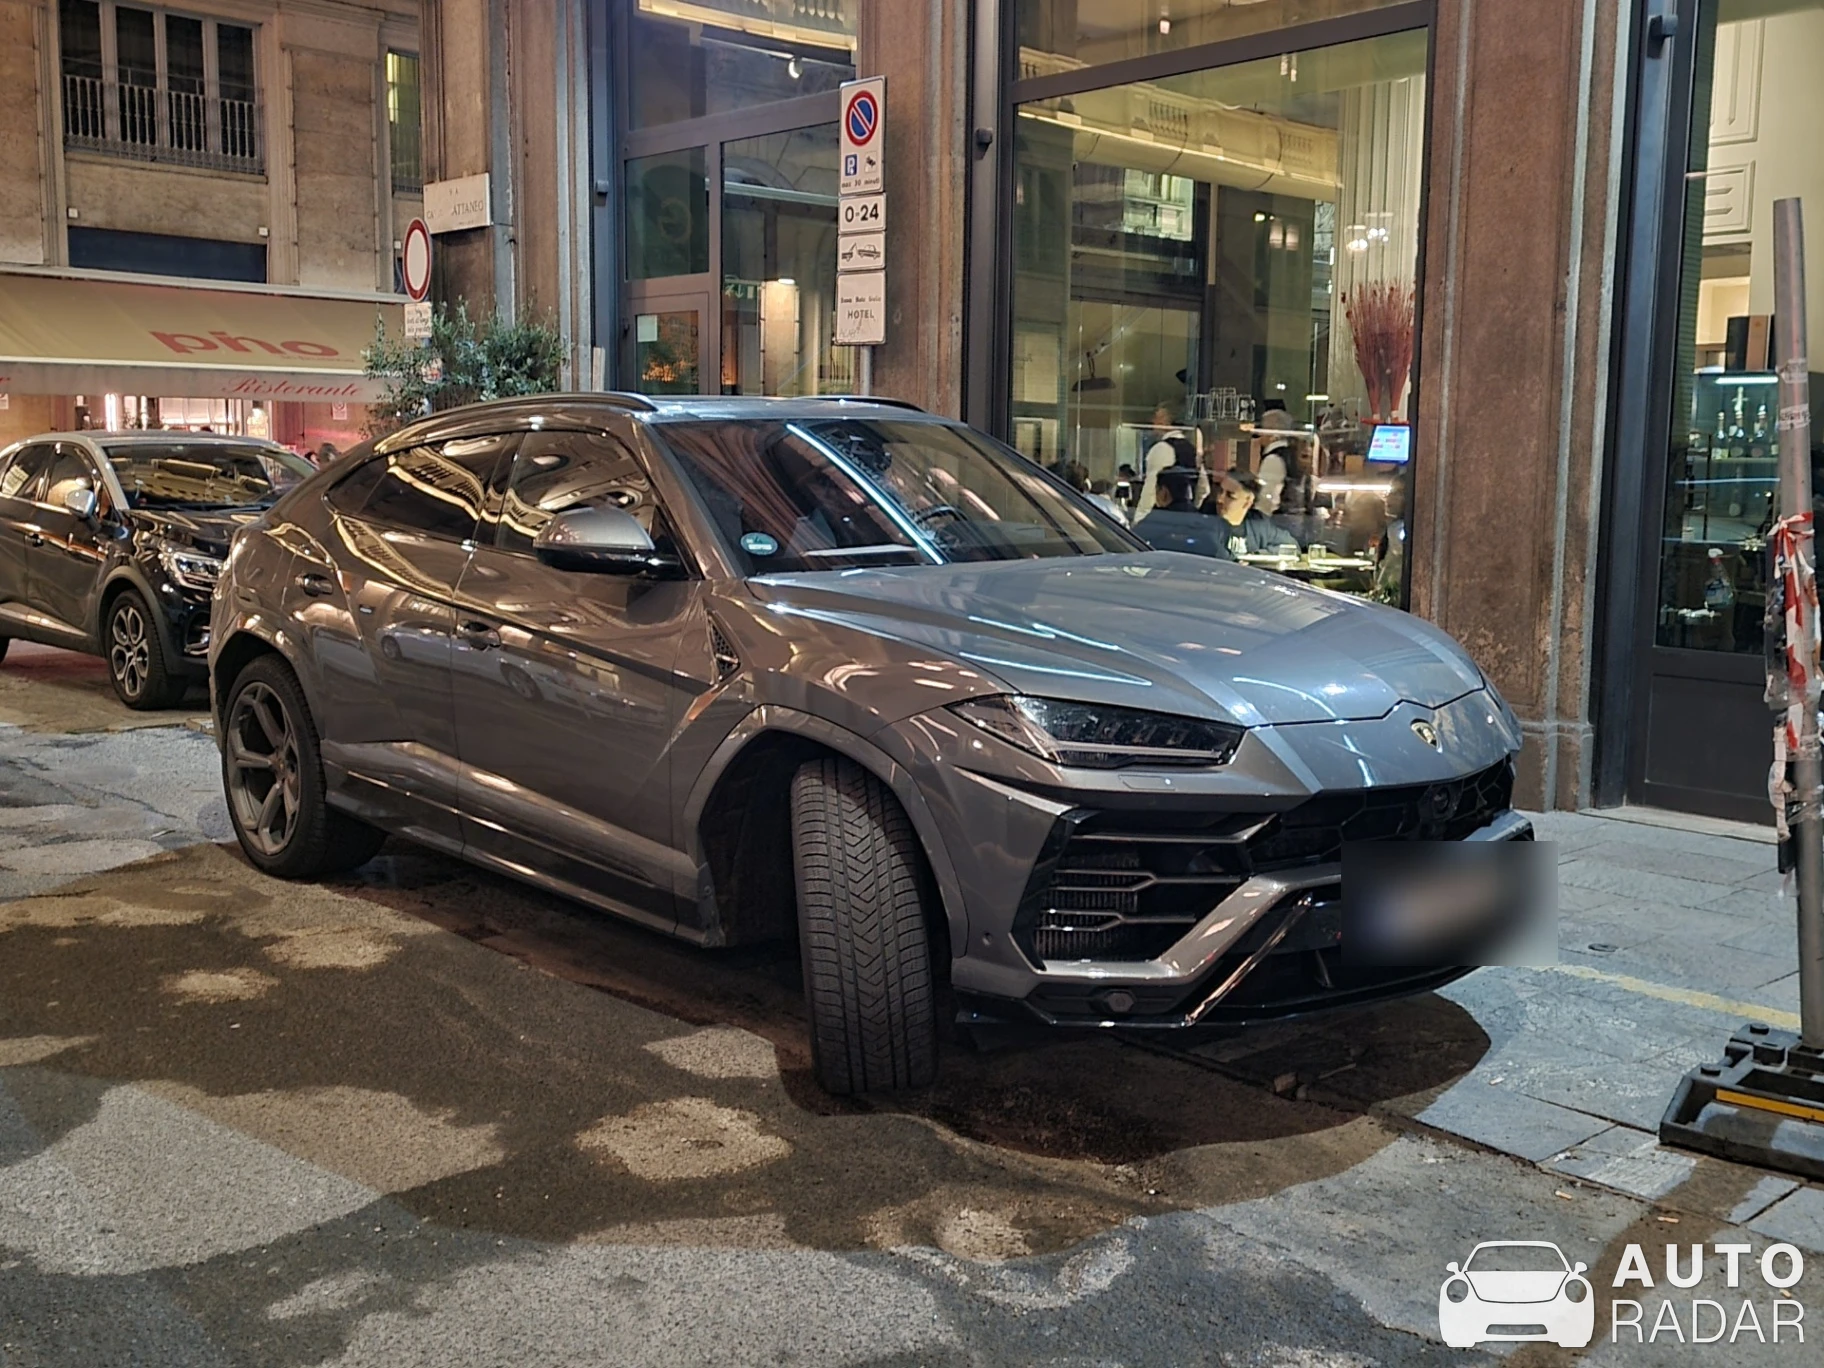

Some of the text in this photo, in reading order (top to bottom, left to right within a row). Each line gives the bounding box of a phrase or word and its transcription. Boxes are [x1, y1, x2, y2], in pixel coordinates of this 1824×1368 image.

[450, 200, 484, 216] ATTANEO
[844, 203, 879, 223] 0-24
[847, 309, 875, 319] HOTEL
[222, 375, 364, 396] Ristorante
